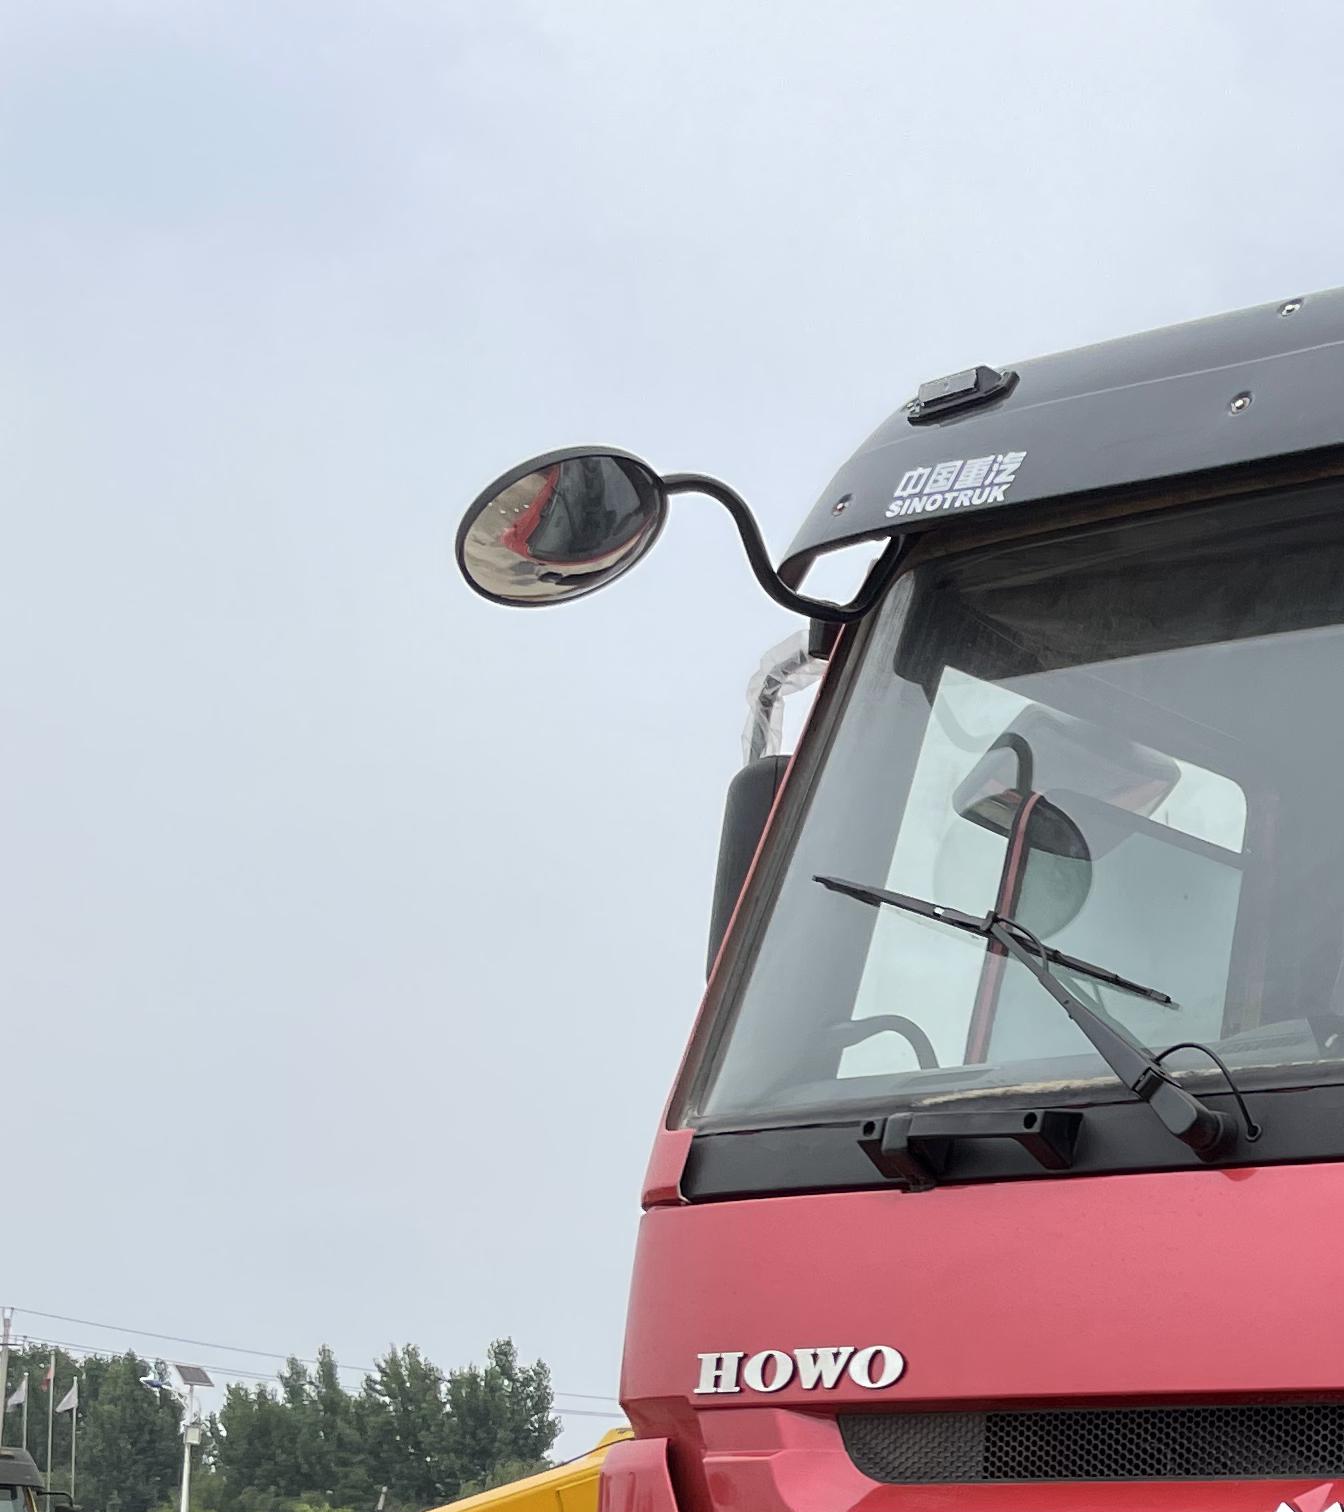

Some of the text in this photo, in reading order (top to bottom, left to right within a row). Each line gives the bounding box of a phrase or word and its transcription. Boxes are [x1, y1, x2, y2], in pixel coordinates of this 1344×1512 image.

[893, 450, 1027, 498] 中国重汽
[885, 483, 1011, 518] SINOTRUK
[693, 1345, 904, 1394] HOWO
